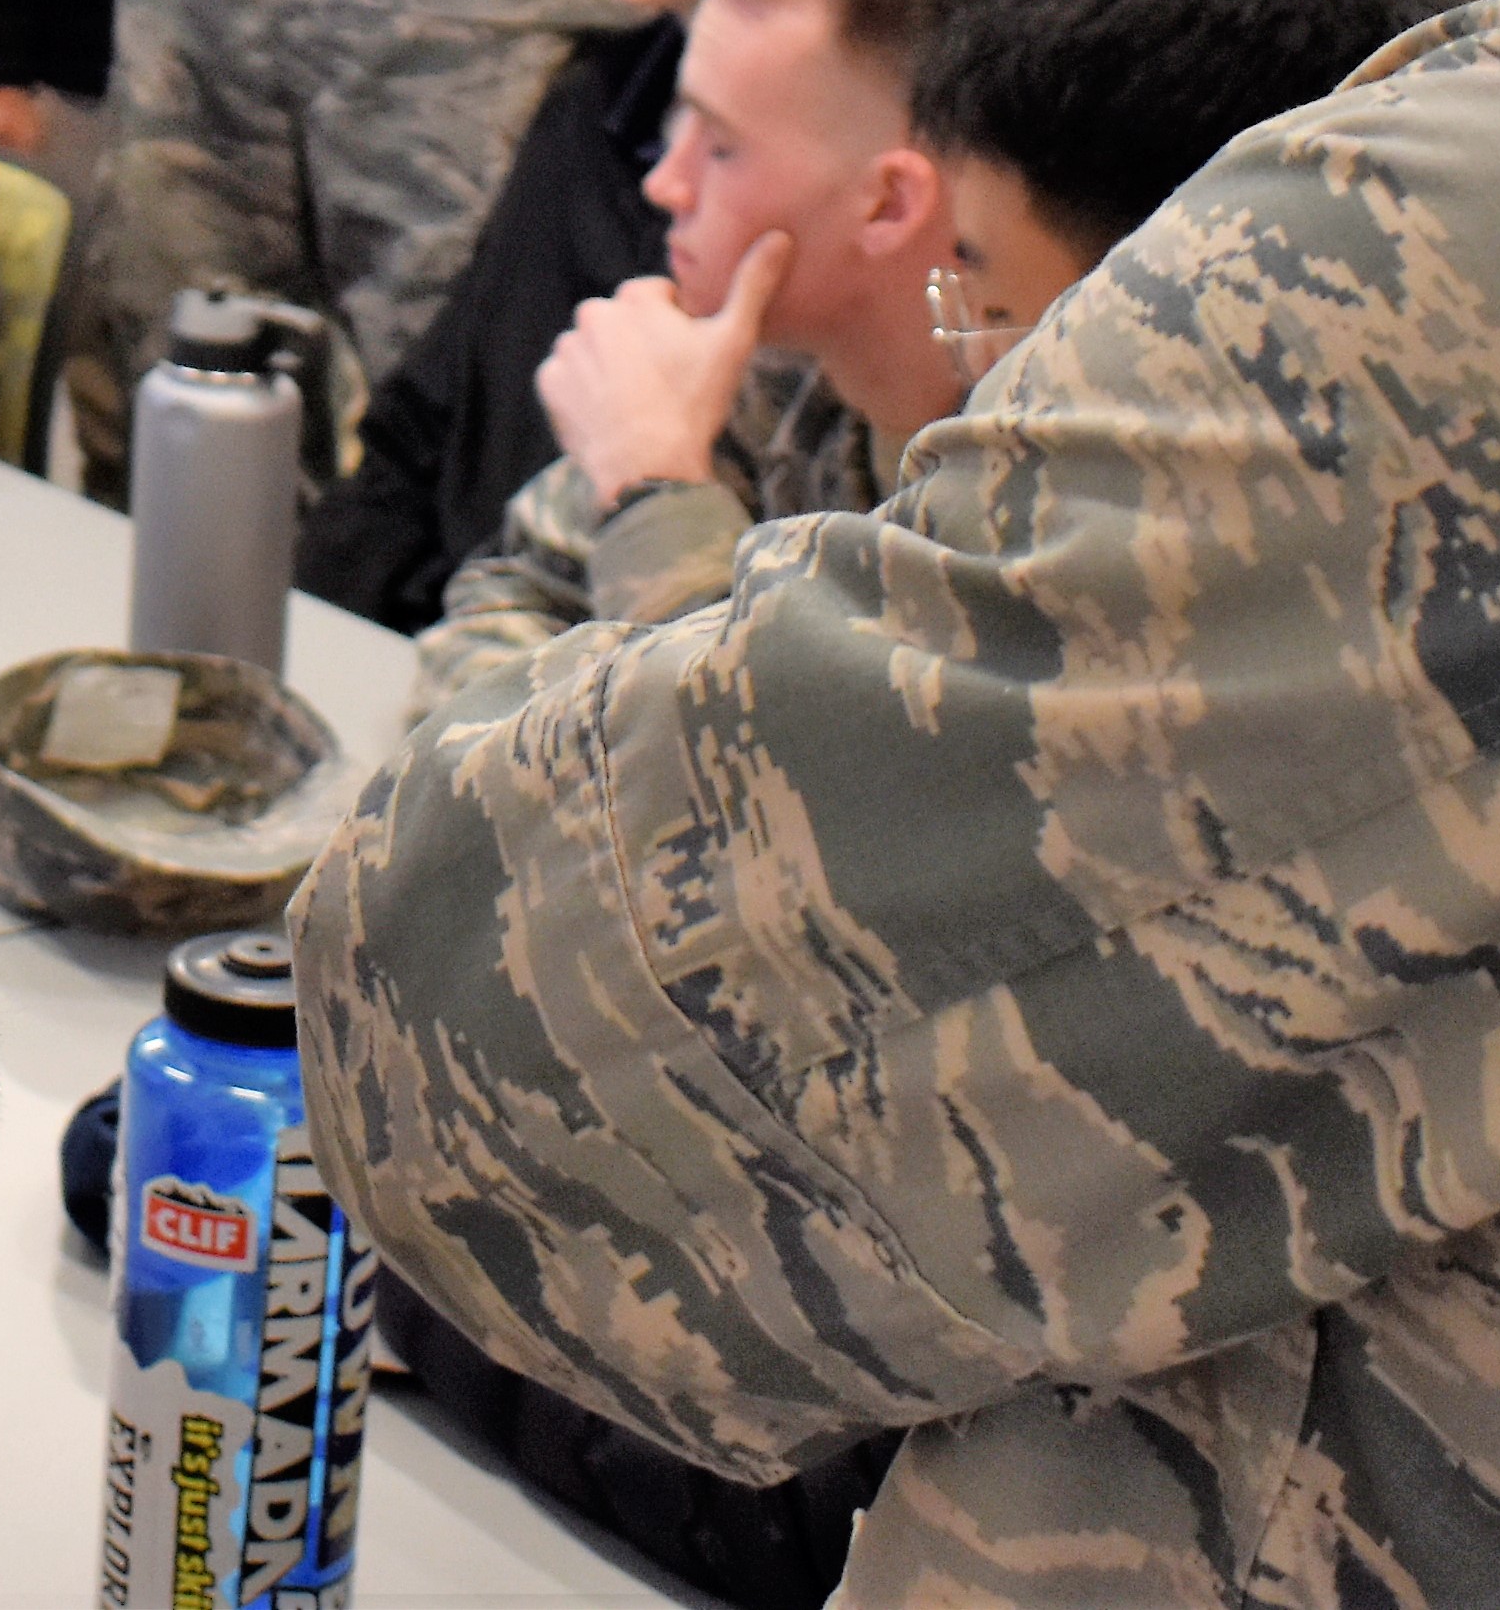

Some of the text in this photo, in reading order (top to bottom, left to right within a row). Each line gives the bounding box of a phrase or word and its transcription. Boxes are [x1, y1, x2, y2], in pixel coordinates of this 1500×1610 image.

[154, 1208, 240, 1252] CLIF
[102, 1408, 138, 1610] EXPLOR
[171, 1414, 222, 1610] it's just ski
